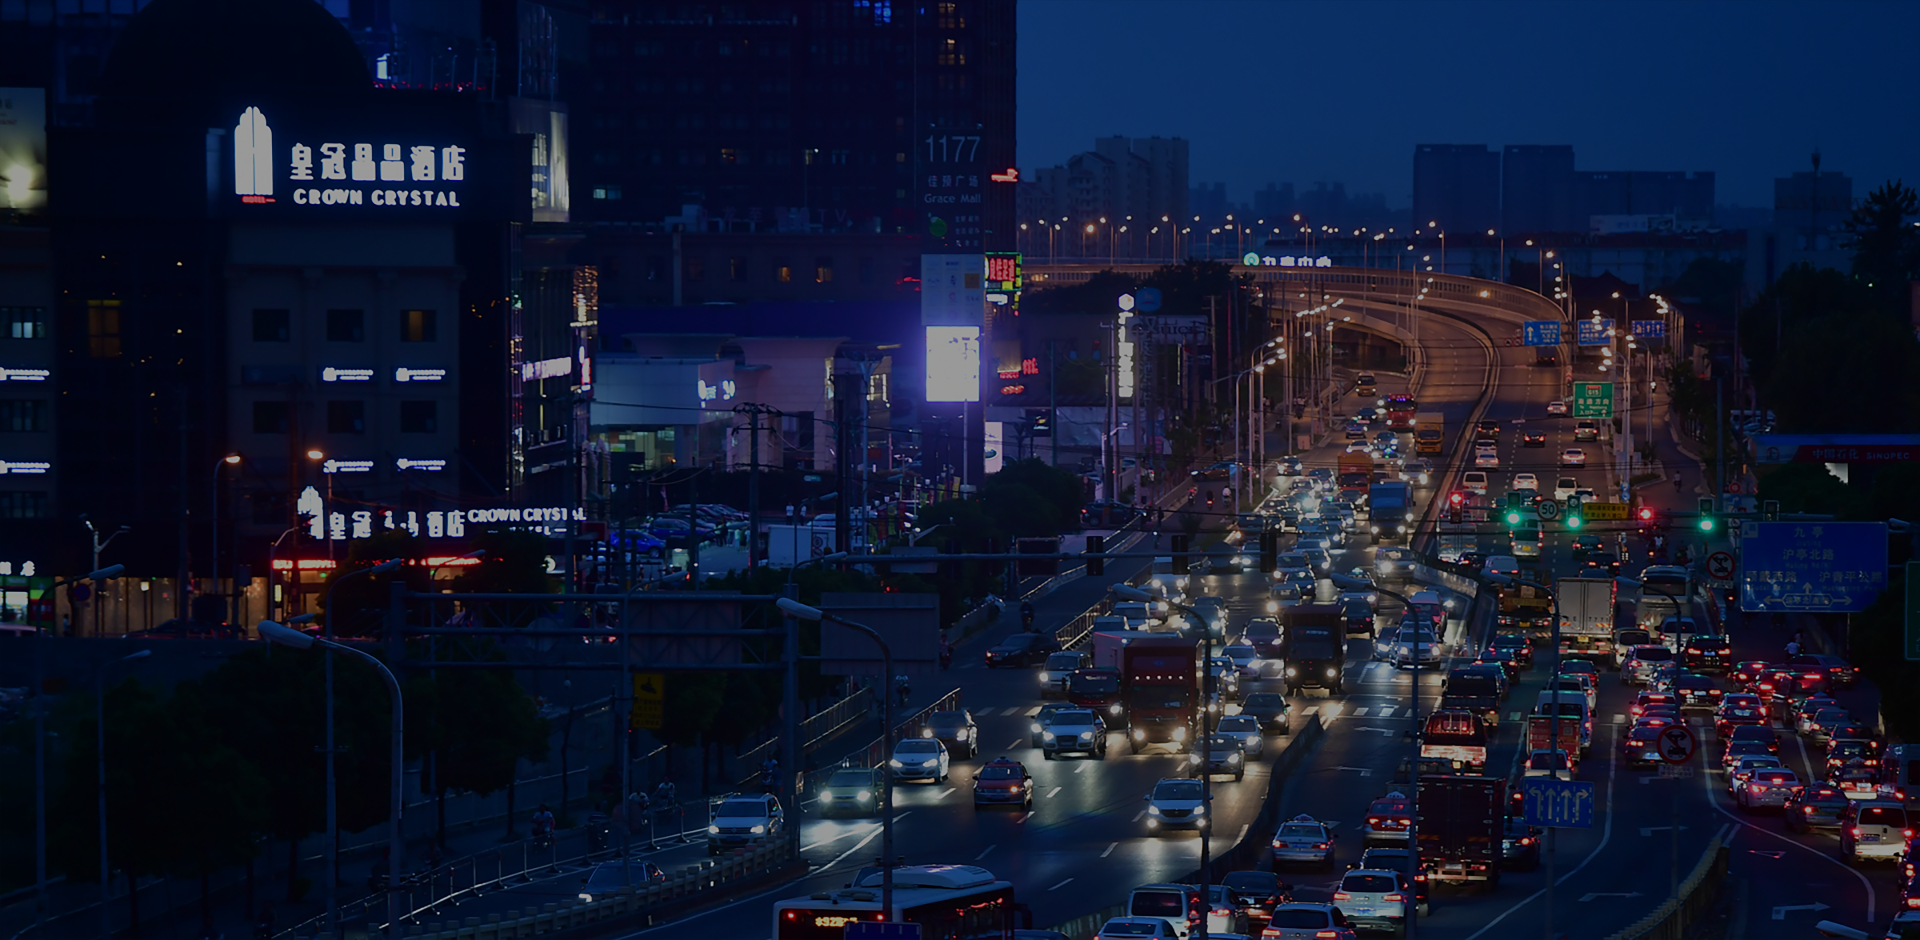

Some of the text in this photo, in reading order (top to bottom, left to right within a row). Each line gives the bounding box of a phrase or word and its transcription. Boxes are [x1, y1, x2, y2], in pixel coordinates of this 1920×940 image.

[925, 134, 981, 162] 1177
[293, 189, 460, 207] CROWN CRYSTAL
[923, 193, 982, 204] Grace Mall
[1813, 449, 1859, 459] 中国石化
[467, 507, 521, 523] CROWN
[1541, 504, 1555, 515] 50
[1782, 548, 1835, 561] 沪亭北路
[1818, 570, 1883, 584] 沪青平公路
